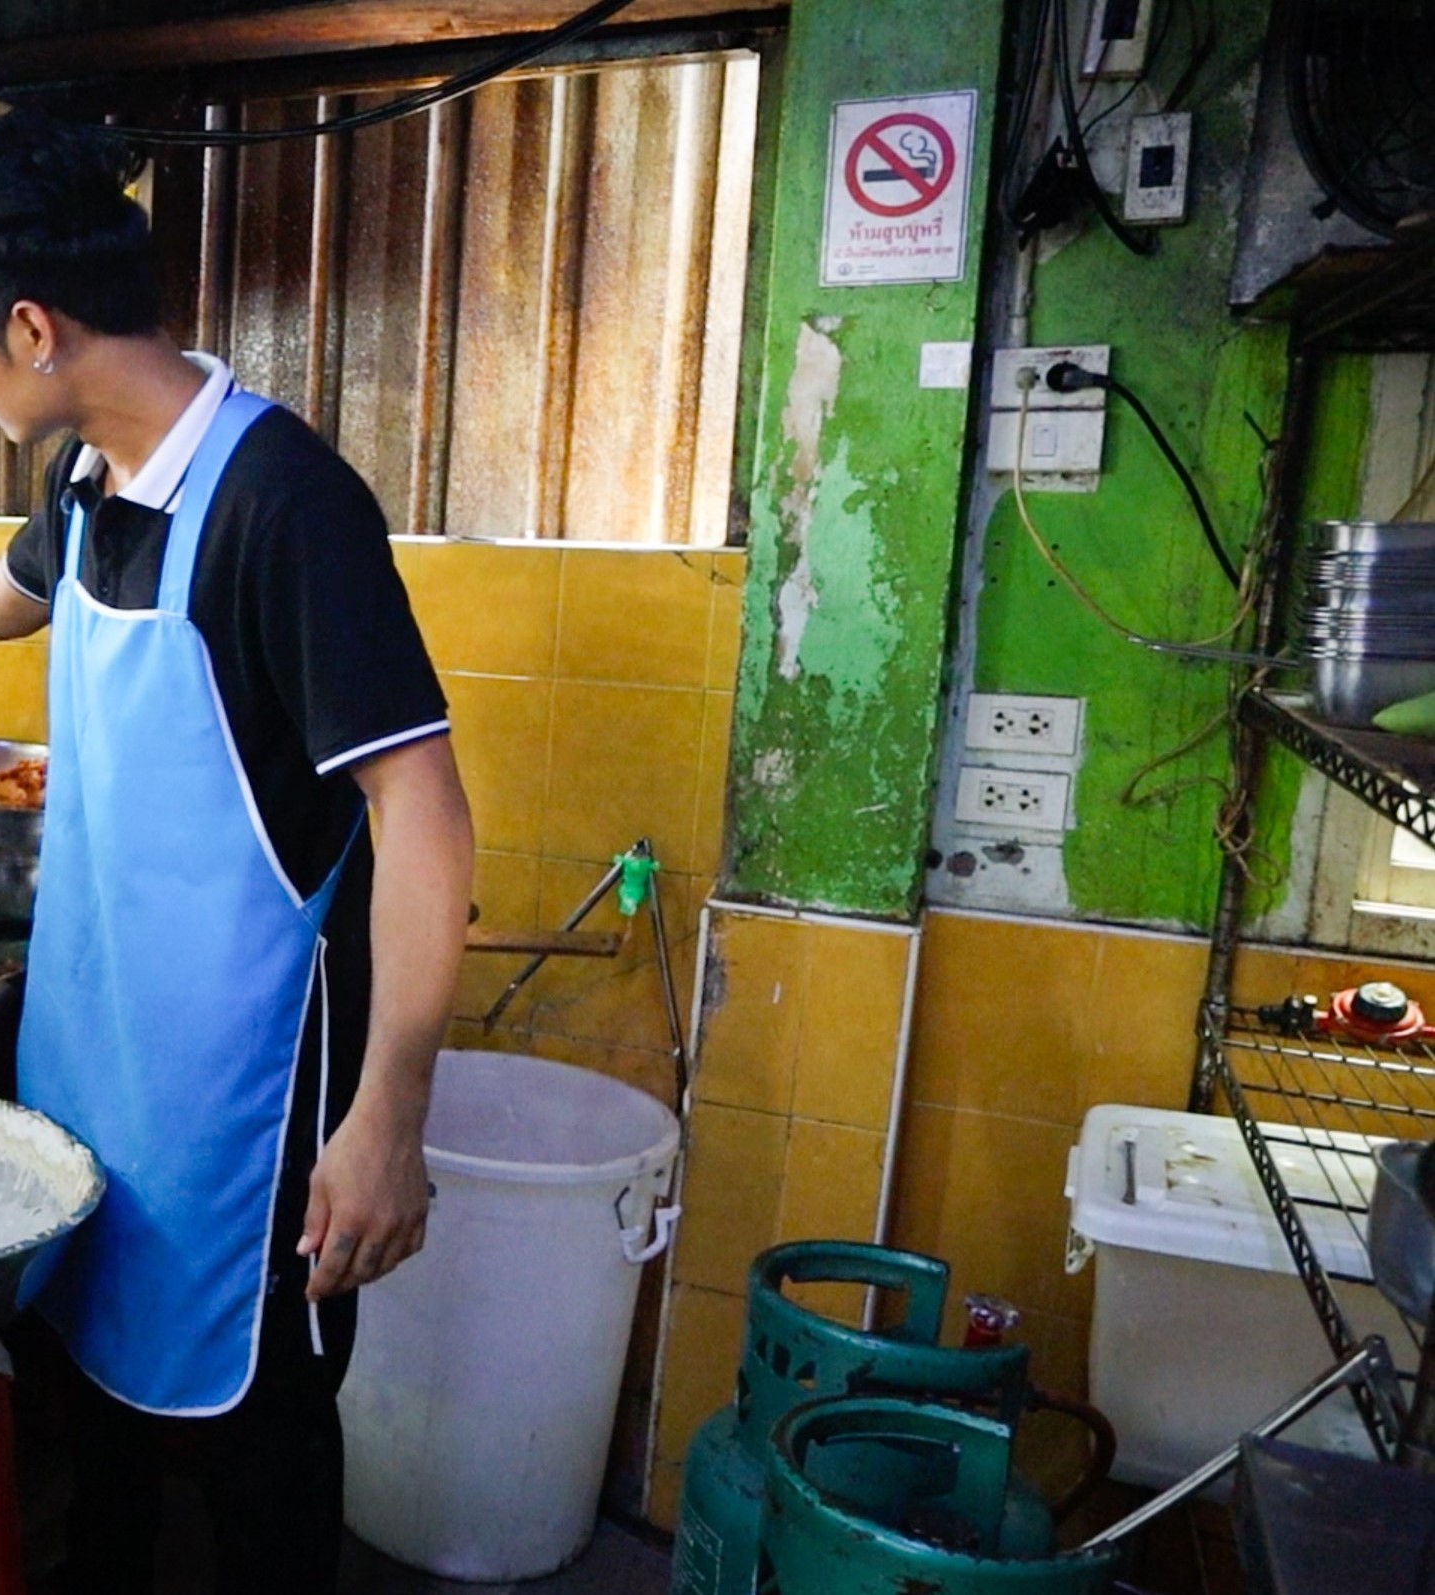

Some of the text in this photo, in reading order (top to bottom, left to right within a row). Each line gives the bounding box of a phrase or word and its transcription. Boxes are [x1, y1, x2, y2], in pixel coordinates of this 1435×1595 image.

[849, 209, 943, 245] ห้ามสูบบุหรี่
